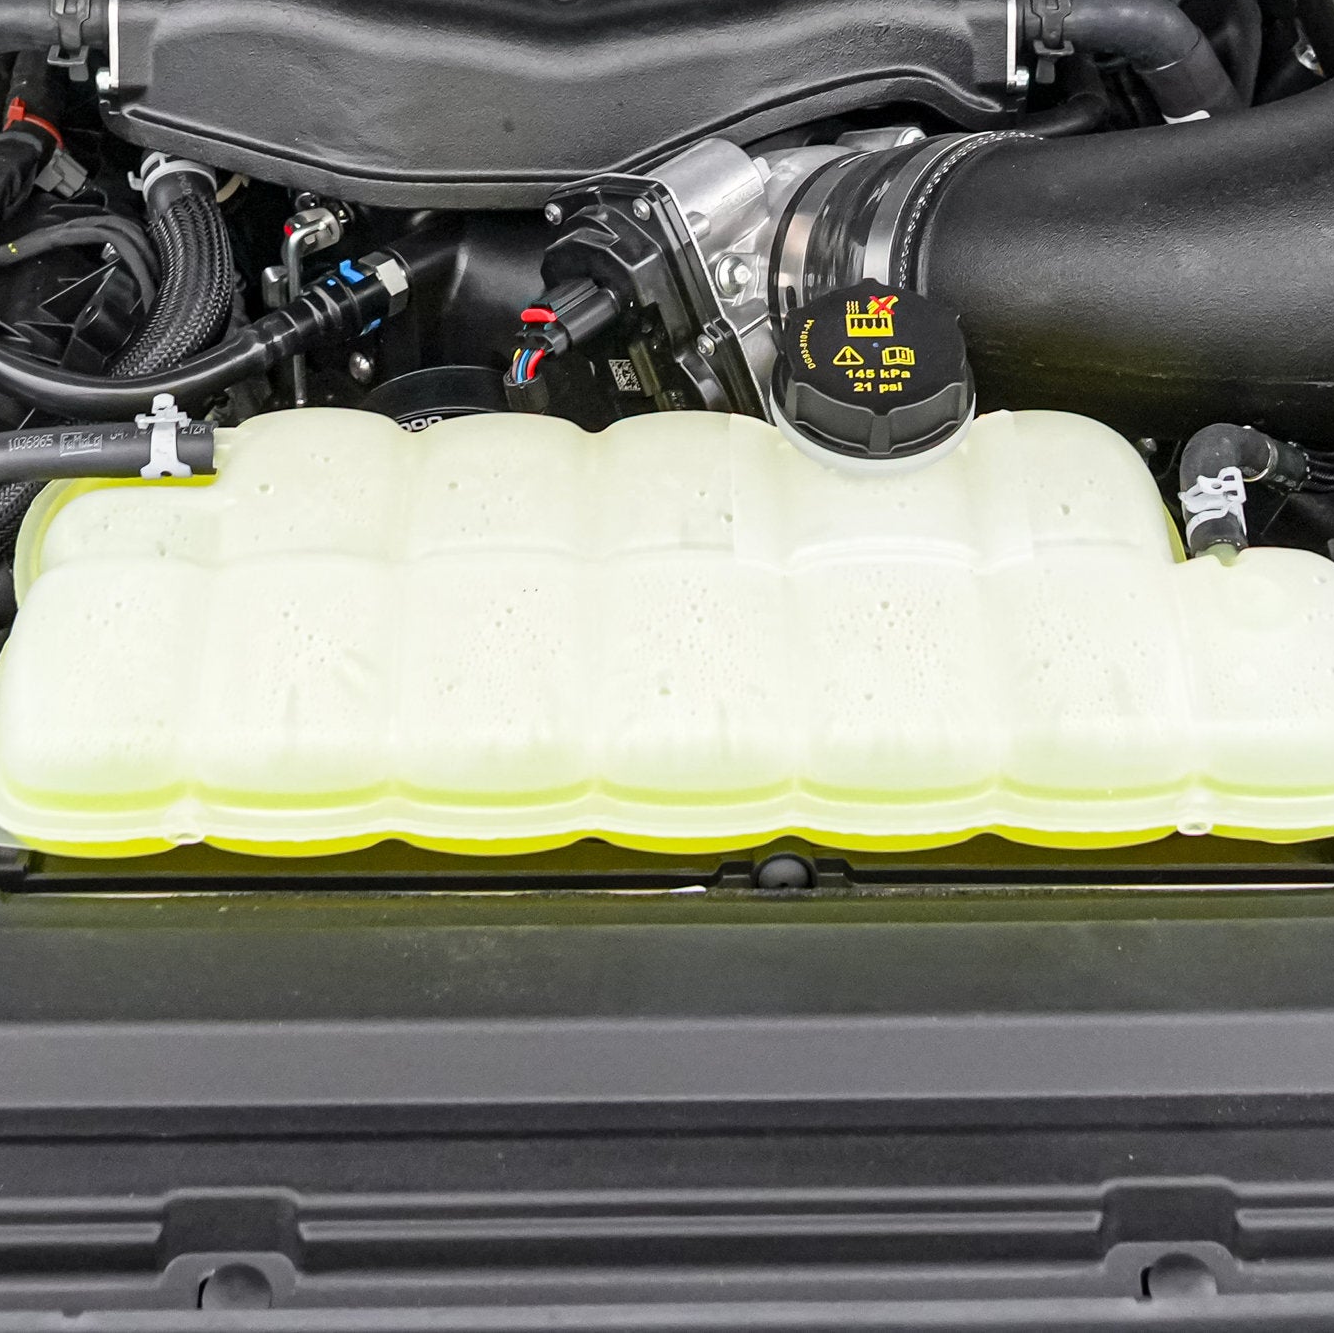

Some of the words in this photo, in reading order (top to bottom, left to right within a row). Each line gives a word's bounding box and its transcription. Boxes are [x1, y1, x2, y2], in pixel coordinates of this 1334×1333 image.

[845, 368, 876, 379] 145
[879, 368, 911, 379] kPa
[853, 382, 873, 392] 21
[878, 381, 903, 394] psi
